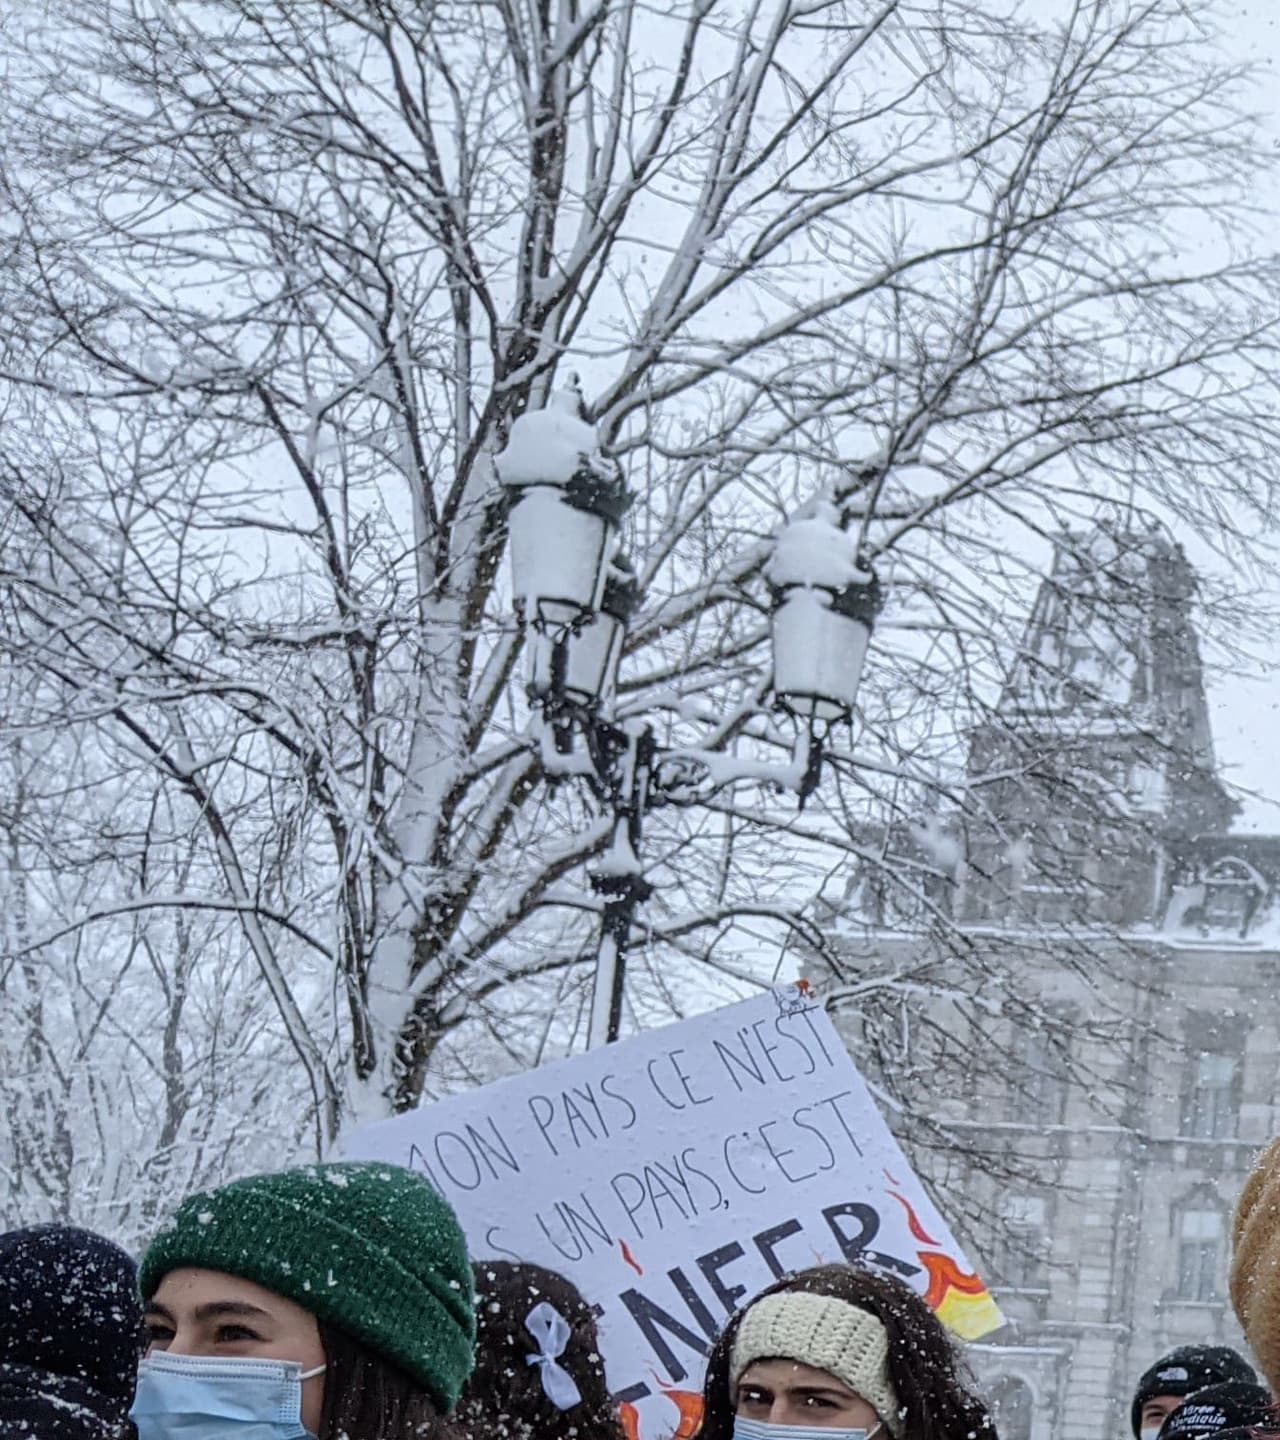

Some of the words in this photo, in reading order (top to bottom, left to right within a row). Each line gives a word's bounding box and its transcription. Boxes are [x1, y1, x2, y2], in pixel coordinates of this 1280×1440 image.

[528, 1074, 637, 1157] PAYS
[647, 1049, 714, 1107] CE
[712, 1004, 834, 1087] N'EST
[535, 1191, 613, 1262] UN
[610, 1148, 730, 1239] PAYS,
[724, 1090, 866, 1194] C'EST
